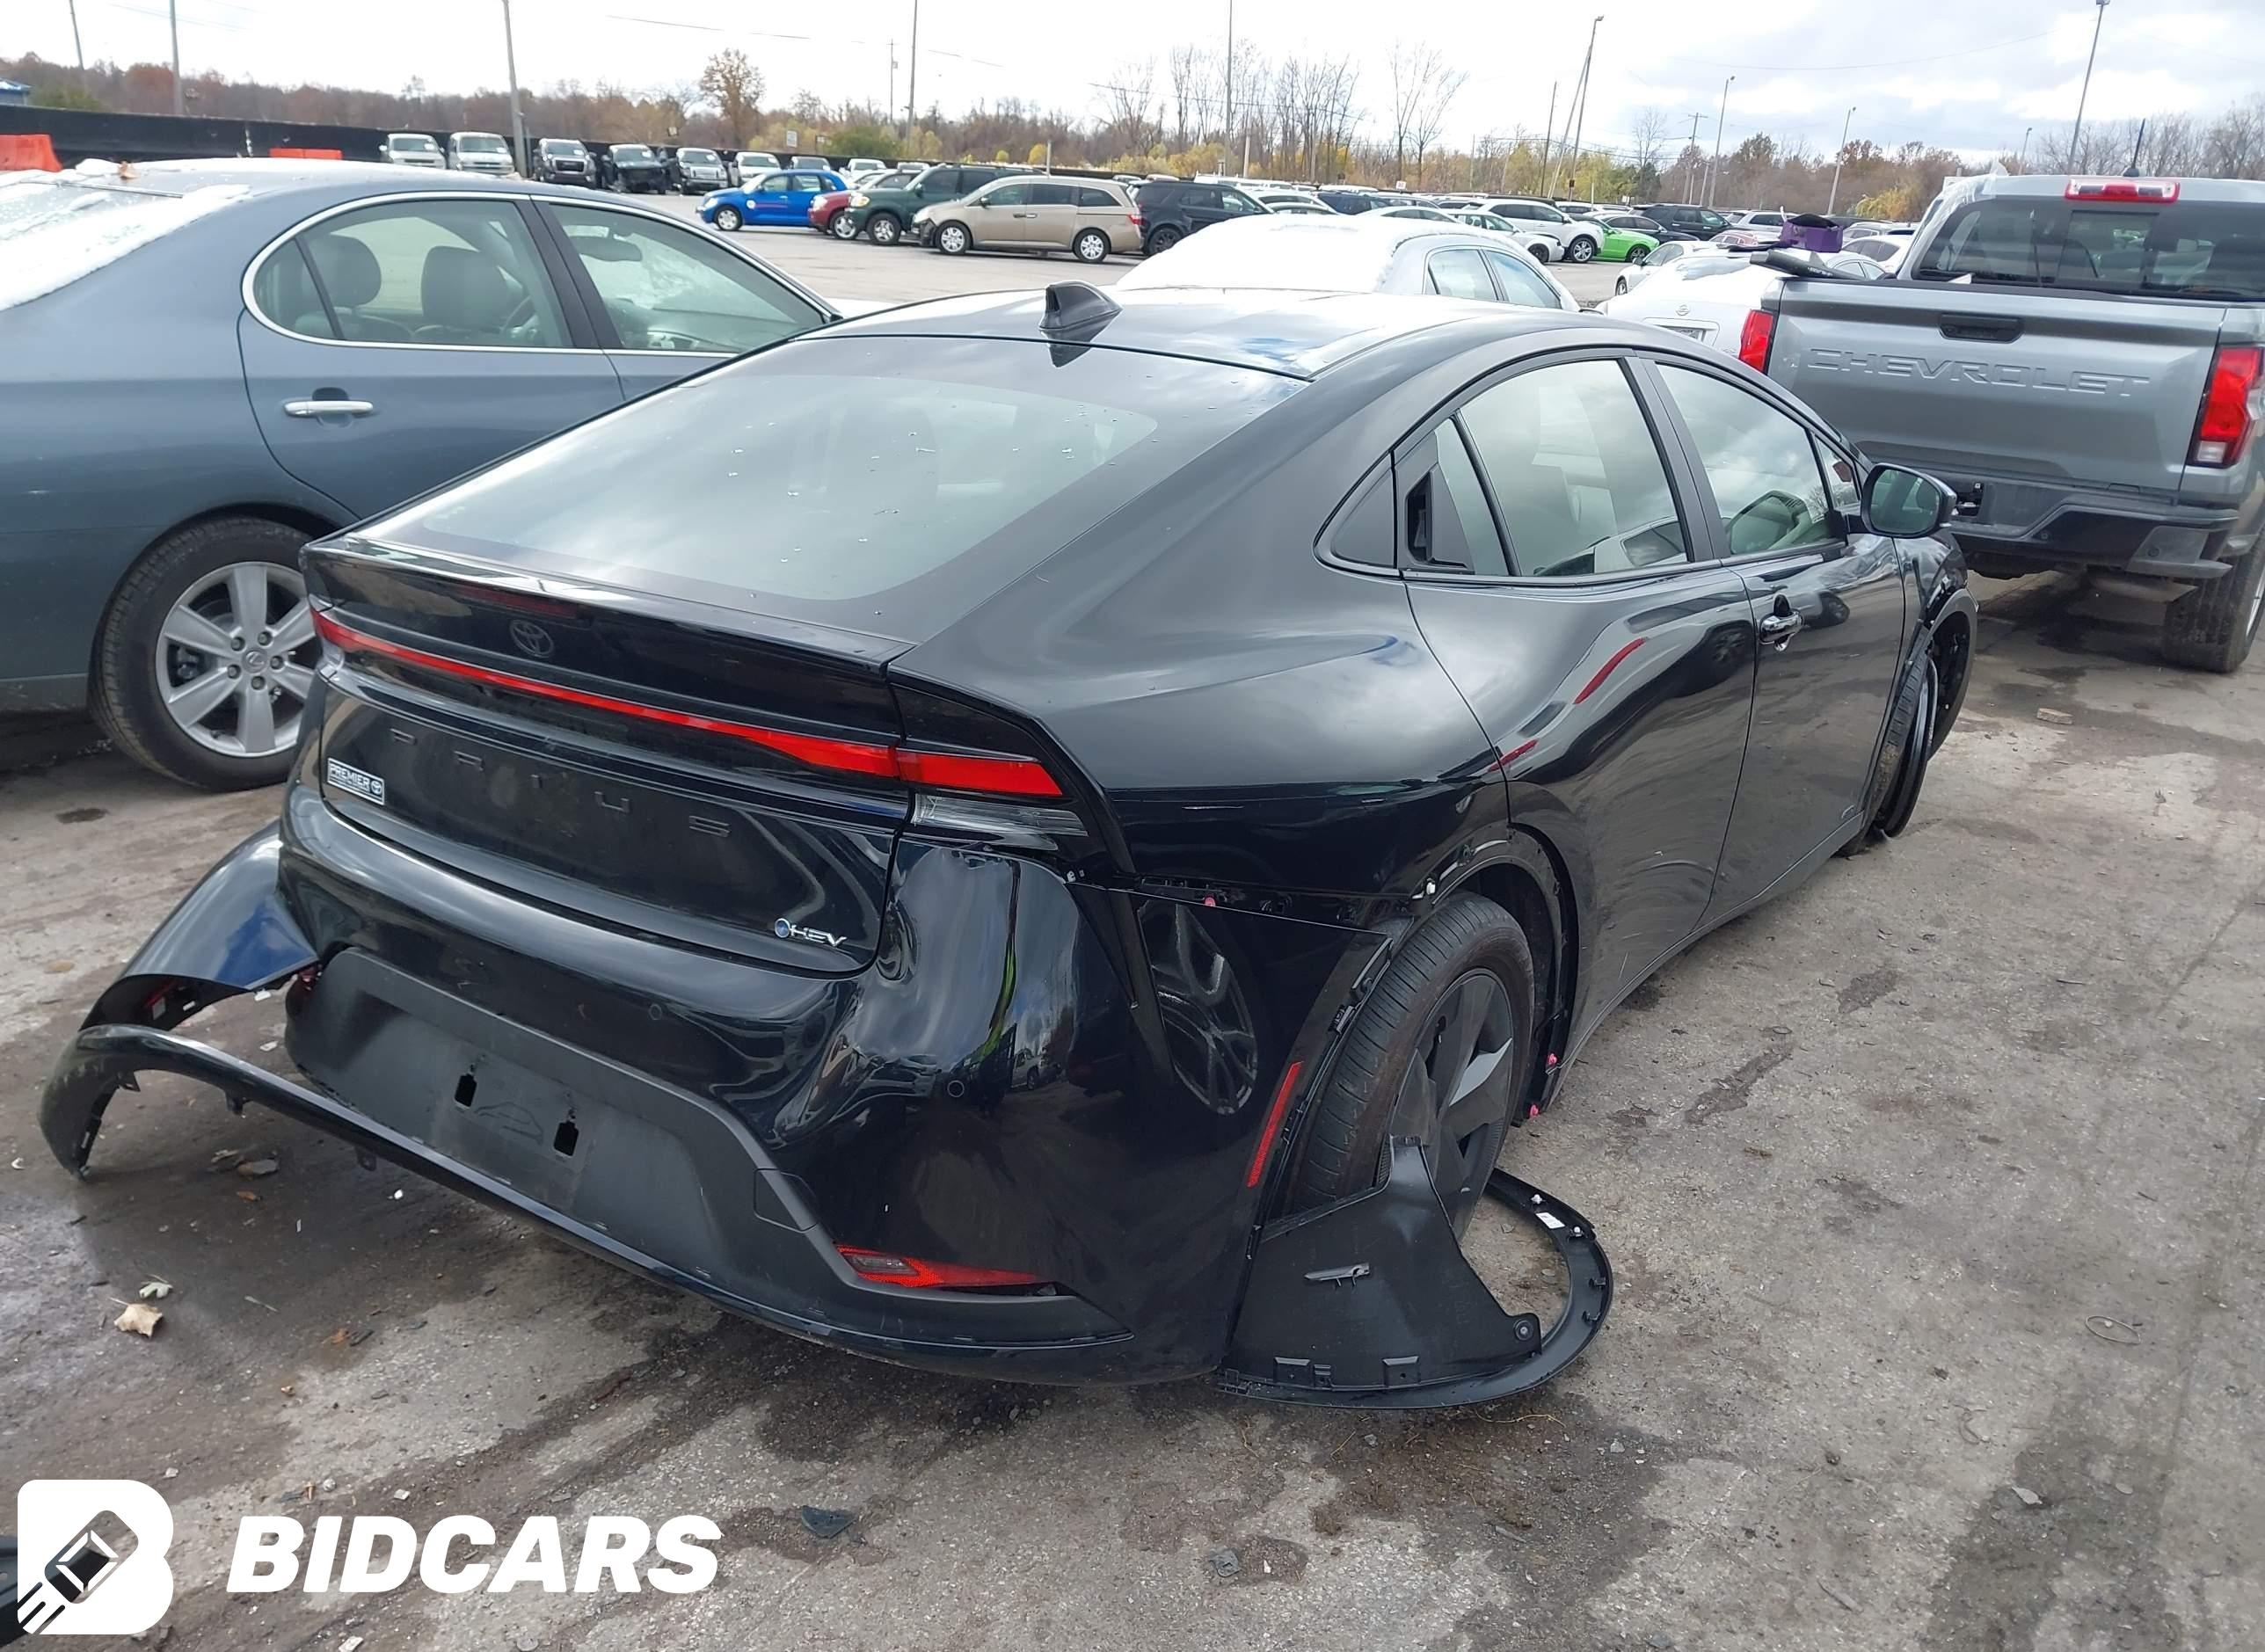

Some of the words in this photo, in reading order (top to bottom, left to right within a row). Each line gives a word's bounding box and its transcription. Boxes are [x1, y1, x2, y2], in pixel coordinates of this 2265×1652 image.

[1808, 349, 2150, 397] CHEVROLET
[329, 763, 370, 792] PREMIER
[390, 728, 732, 839] PRIUS
